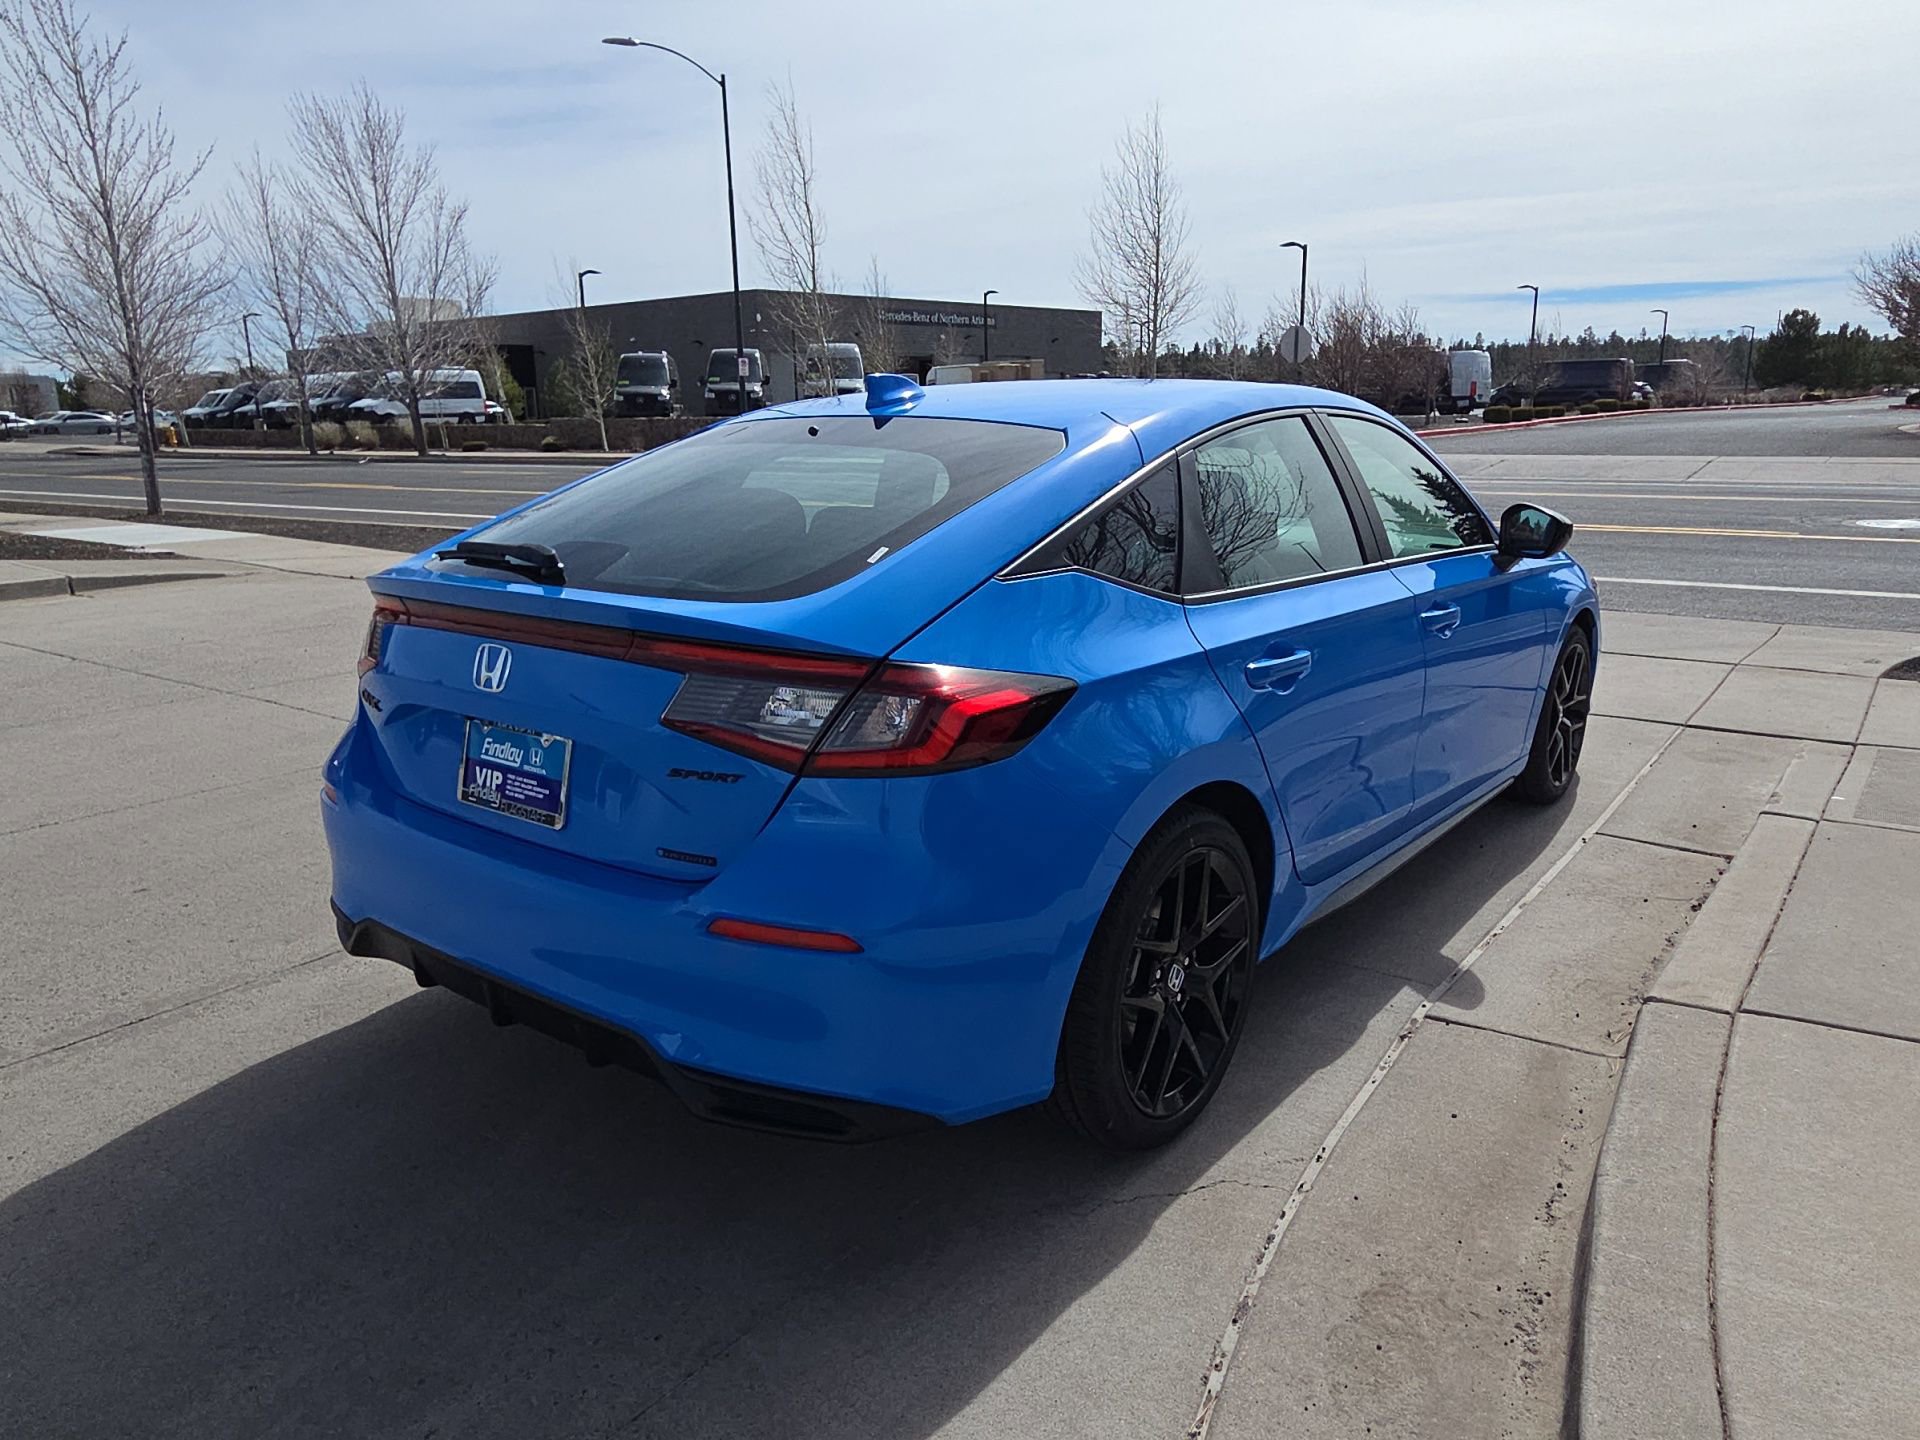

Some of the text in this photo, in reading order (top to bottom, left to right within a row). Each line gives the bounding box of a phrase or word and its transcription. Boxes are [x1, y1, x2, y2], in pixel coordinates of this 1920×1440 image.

[940, 313, 970, 325] Northern
[972, 315, 995, 326] Arizna
[481, 738, 523, 767] Findlay
[475, 766, 503, 791] VIP
[666, 768, 747, 784] SPORT
[469, 783, 501, 807] Findlay
